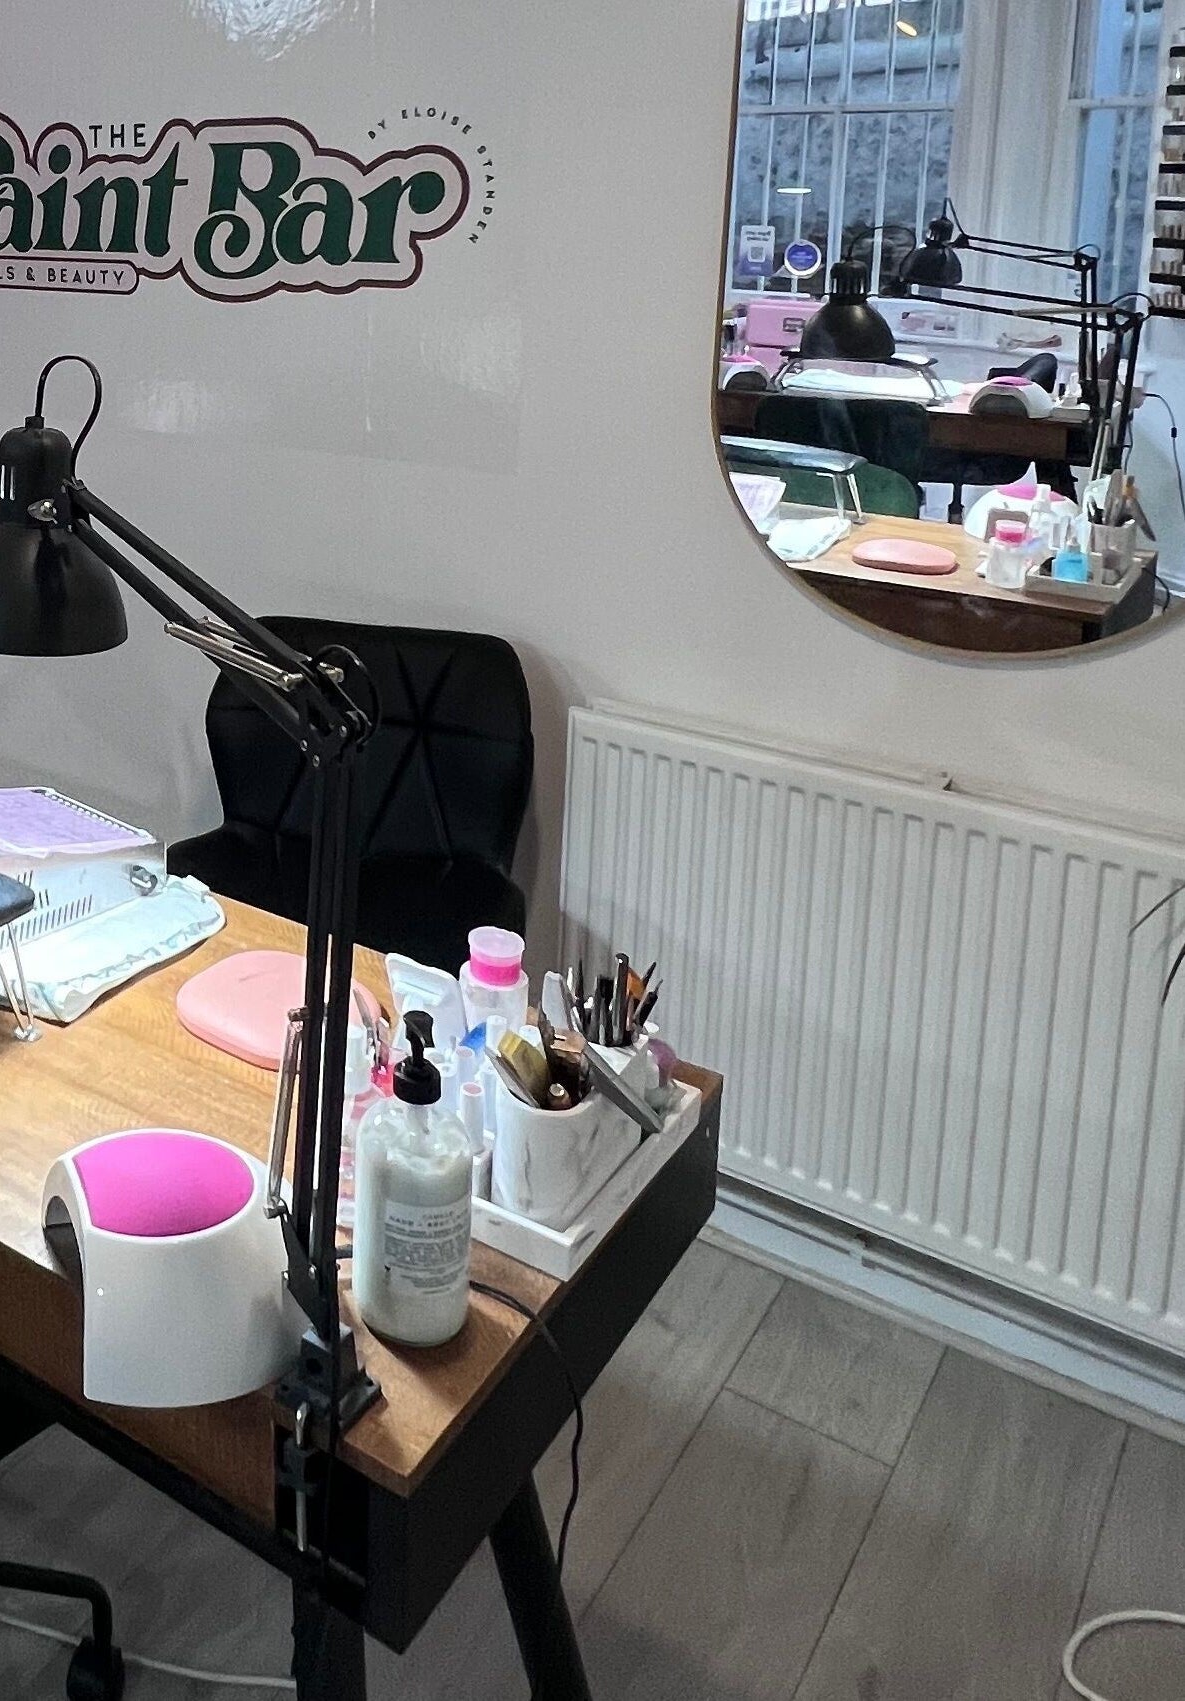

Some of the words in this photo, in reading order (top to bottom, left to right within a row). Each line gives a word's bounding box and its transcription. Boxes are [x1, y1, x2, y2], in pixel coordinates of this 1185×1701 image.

[88, 123, 146, 148] THE
[368, 119, 386, 139] BY
[401, 107, 472, 134] ELOISE
[468, 145, 496, 244] STANDEN
[194, 141, 446, 279] Bar
[26, 266, 36, 281] &
[47, 267, 125, 285] BEAUTY
